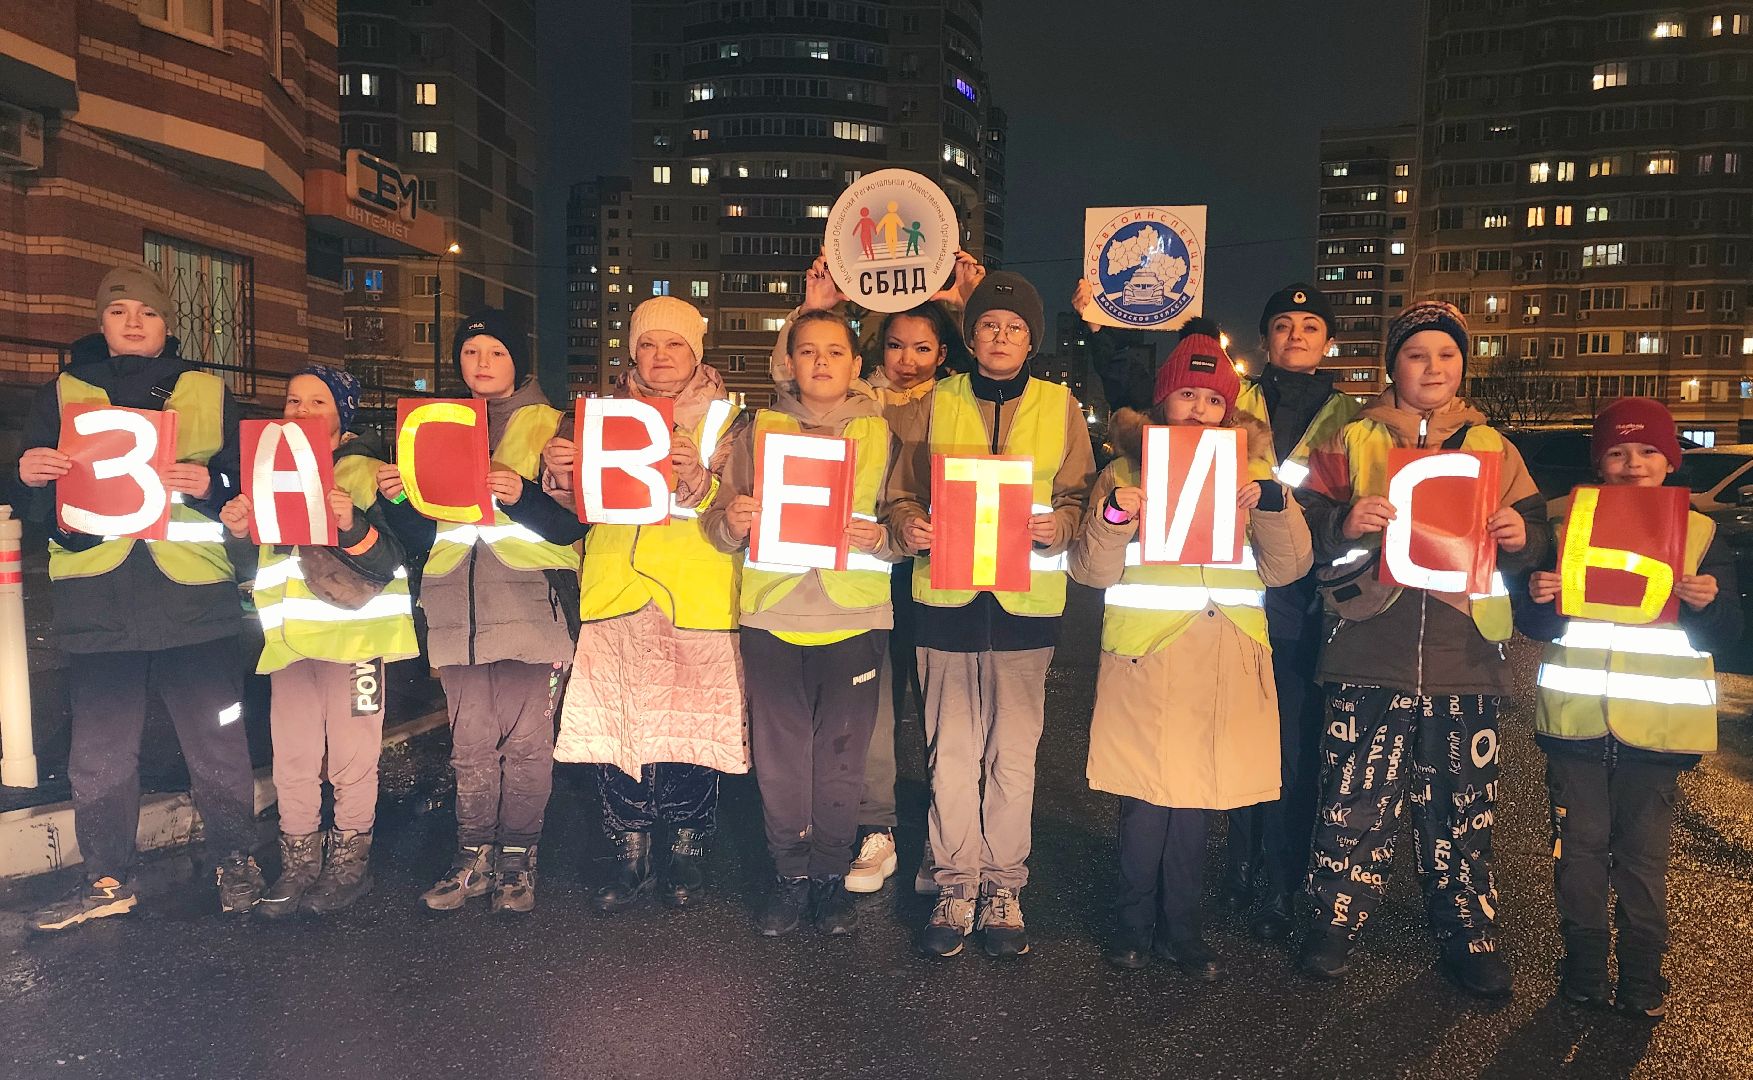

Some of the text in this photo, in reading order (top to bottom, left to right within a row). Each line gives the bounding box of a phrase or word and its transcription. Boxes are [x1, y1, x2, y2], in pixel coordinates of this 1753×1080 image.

[854, 178, 905, 200] Региональная
[907, 179, 946, 223] Общественная
[833, 198, 856, 237] Областная
[832, 238, 853, 285] Московская
[859, 267, 927, 296] СБДД
[61, 409, 167, 535] З
[252, 421, 330, 545] А
[396, 402, 483, 525] С
[581, 398, 671, 524] В
[755, 433, 846, 570] Е
[945, 458, 1033, 586] Т
[1143, 427, 1242, 562] И
[1383, 452, 1481, 592] С
[1362, 725, 1388, 790] REAL one
[1386, 735, 1404, 780] original
